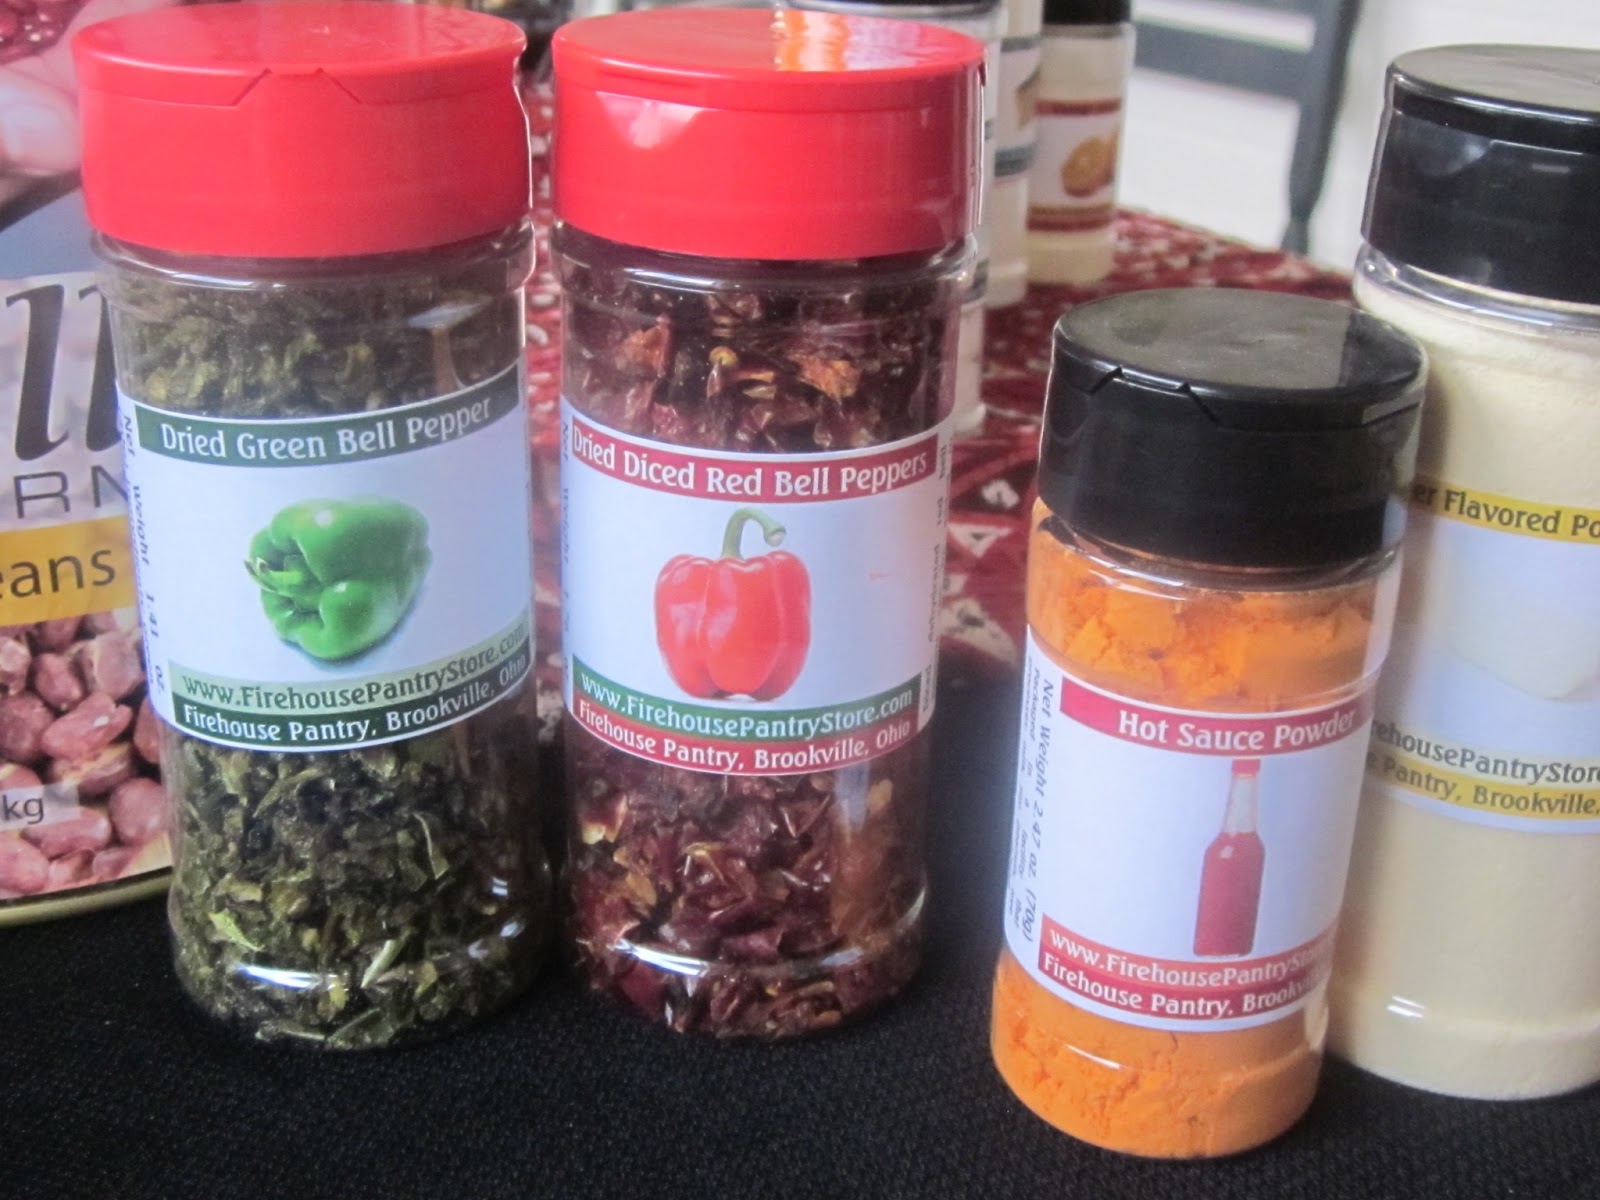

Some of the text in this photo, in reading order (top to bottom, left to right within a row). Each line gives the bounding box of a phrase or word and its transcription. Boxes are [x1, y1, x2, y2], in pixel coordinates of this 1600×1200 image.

[160, 397, 491, 460] Dried Green Bell Pepper
[572, 426, 615, 470] Dried
[623, 445, 695, 489] Diced
[707, 466, 761, 496] Red
[774, 467, 828, 496] Bell
[840, 450, 927, 493] Peppers
[1445, 489, 1562, 534] Flavored
[0, 549, 116, 599] ans
[183, 622, 525, 710] www.FirehousePantryStore.com
[184, 705, 281, 741] Firehouse
[289, 714, 377, 741] Pantry,
[386, 679, 494, 733] Brookville,
[499, 653, 526, 687] Ohio
[581, 672, 912, 740] www.FirehousePantryStore.com
[1042, 680, 1054, 718] Net
[1119, 708, 1356, 751] Hot Sauce Powder
[579, 699, 911, 771] Firehouse Pantry, Brookville, Ohio
[1035, 725, 1051, 796] Weight
[3, 794, 44, 825] kg
[1044, 953, 1142, 1009] Firehouse
